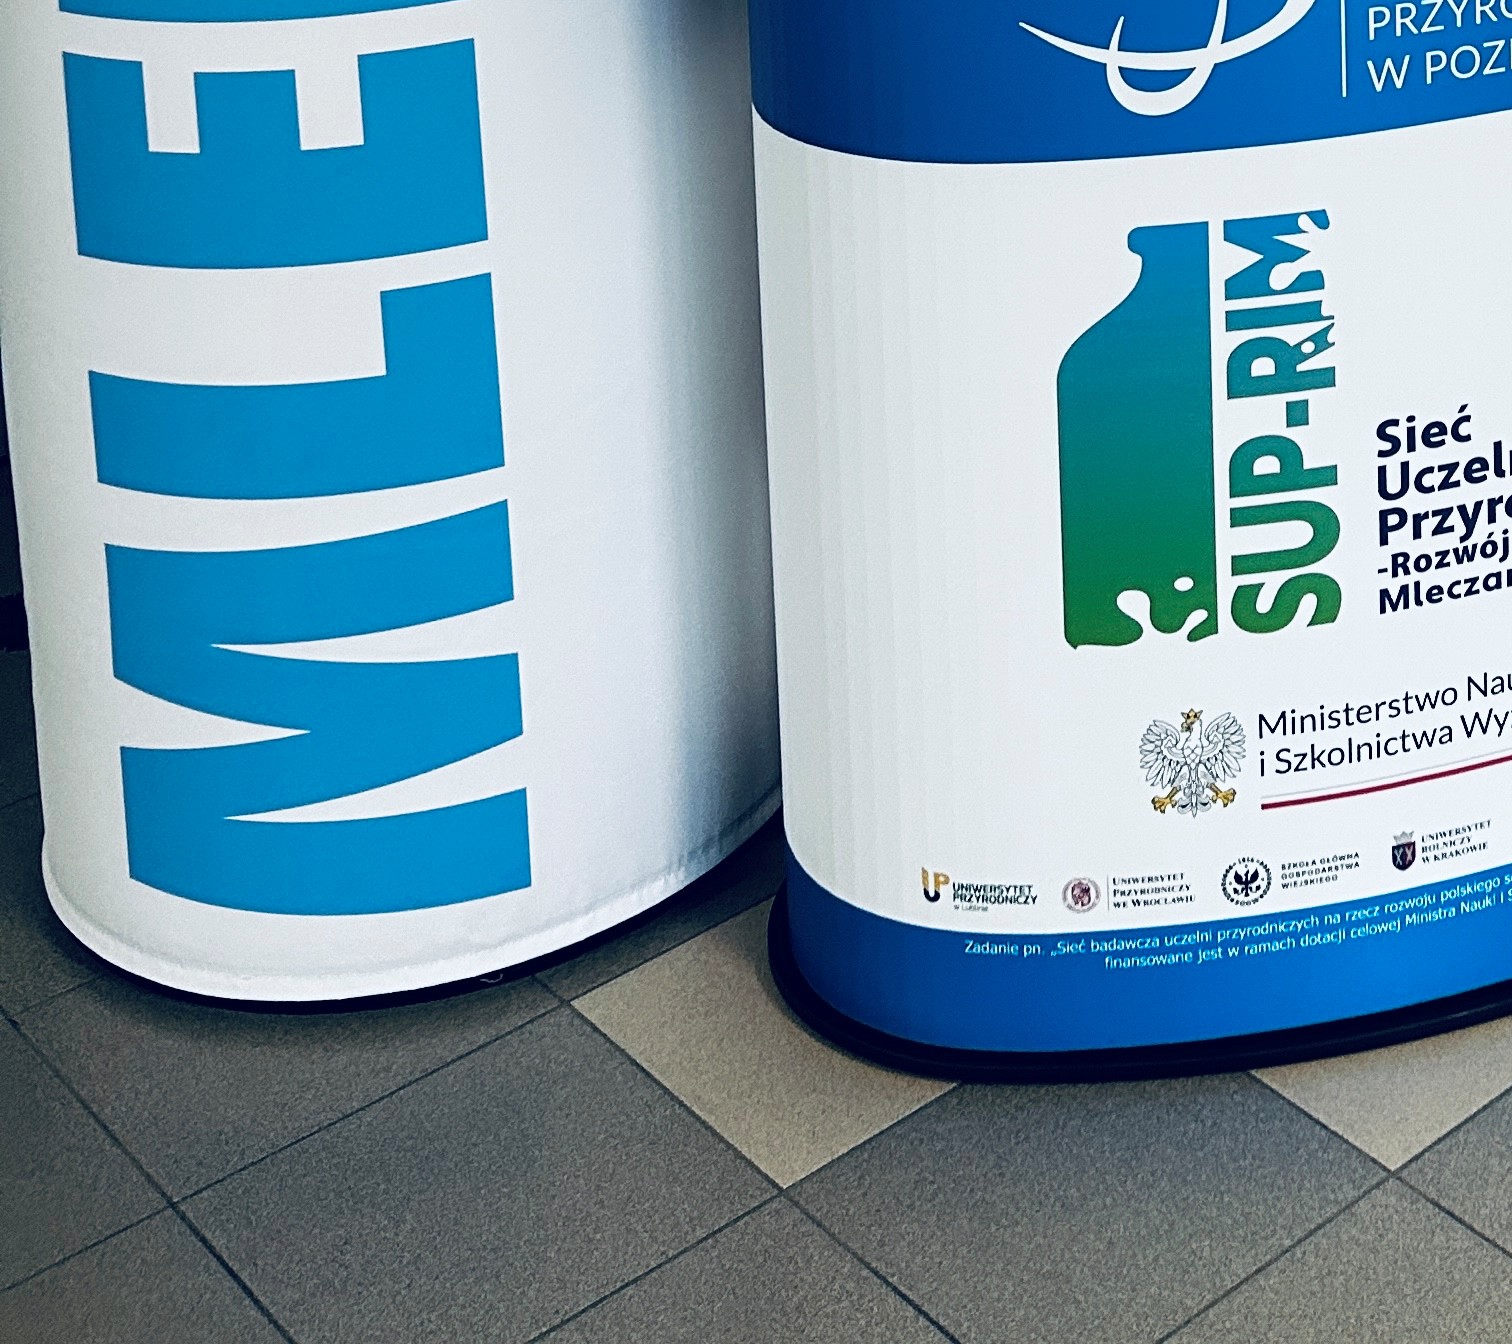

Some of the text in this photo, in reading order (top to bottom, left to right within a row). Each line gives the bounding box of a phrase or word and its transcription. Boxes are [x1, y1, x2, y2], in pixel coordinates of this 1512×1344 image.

[1366, 53, 1411, 94] W
[1222, 208, 1342, 634] SUP-RIM
[1375, 403, 1473, 459] Sieć
[1377, 528, 1511, 580] -Rozwój
[1257, 685, 1459, 740] Ministerstwo
[1259, 749, 1266, 777] i
[1274, 725, 1454, 776] Szkolnictwa
[964, 939, 1019, 956] Zadanie
[1090, 934, 1160, 953] badawcza
[1164, 928, 1213, 947] uczelni
[1217, 914, 1319, 944] przyrodniczych
[1323, 913, 1342, 927] na
[1345, 905, 1381, 923] rzecz
[1383, 890, 1437, 917] rozwoju
[1440, 875, 1501, 905] polskiego
[1104, 950, 1194, 971] finansowane
[1197, 947, 1223, 965] jest
[1226, 946, 1240, 959] w
[1244, 937, 1297, 956] ramach
[1299, 927, 1347, 949] dotacji
[1349, 917, 1402, 941] celowej
[1404, 907, 1457, 928] Ministra
[1459, 894, 1497, 917] Nauki
